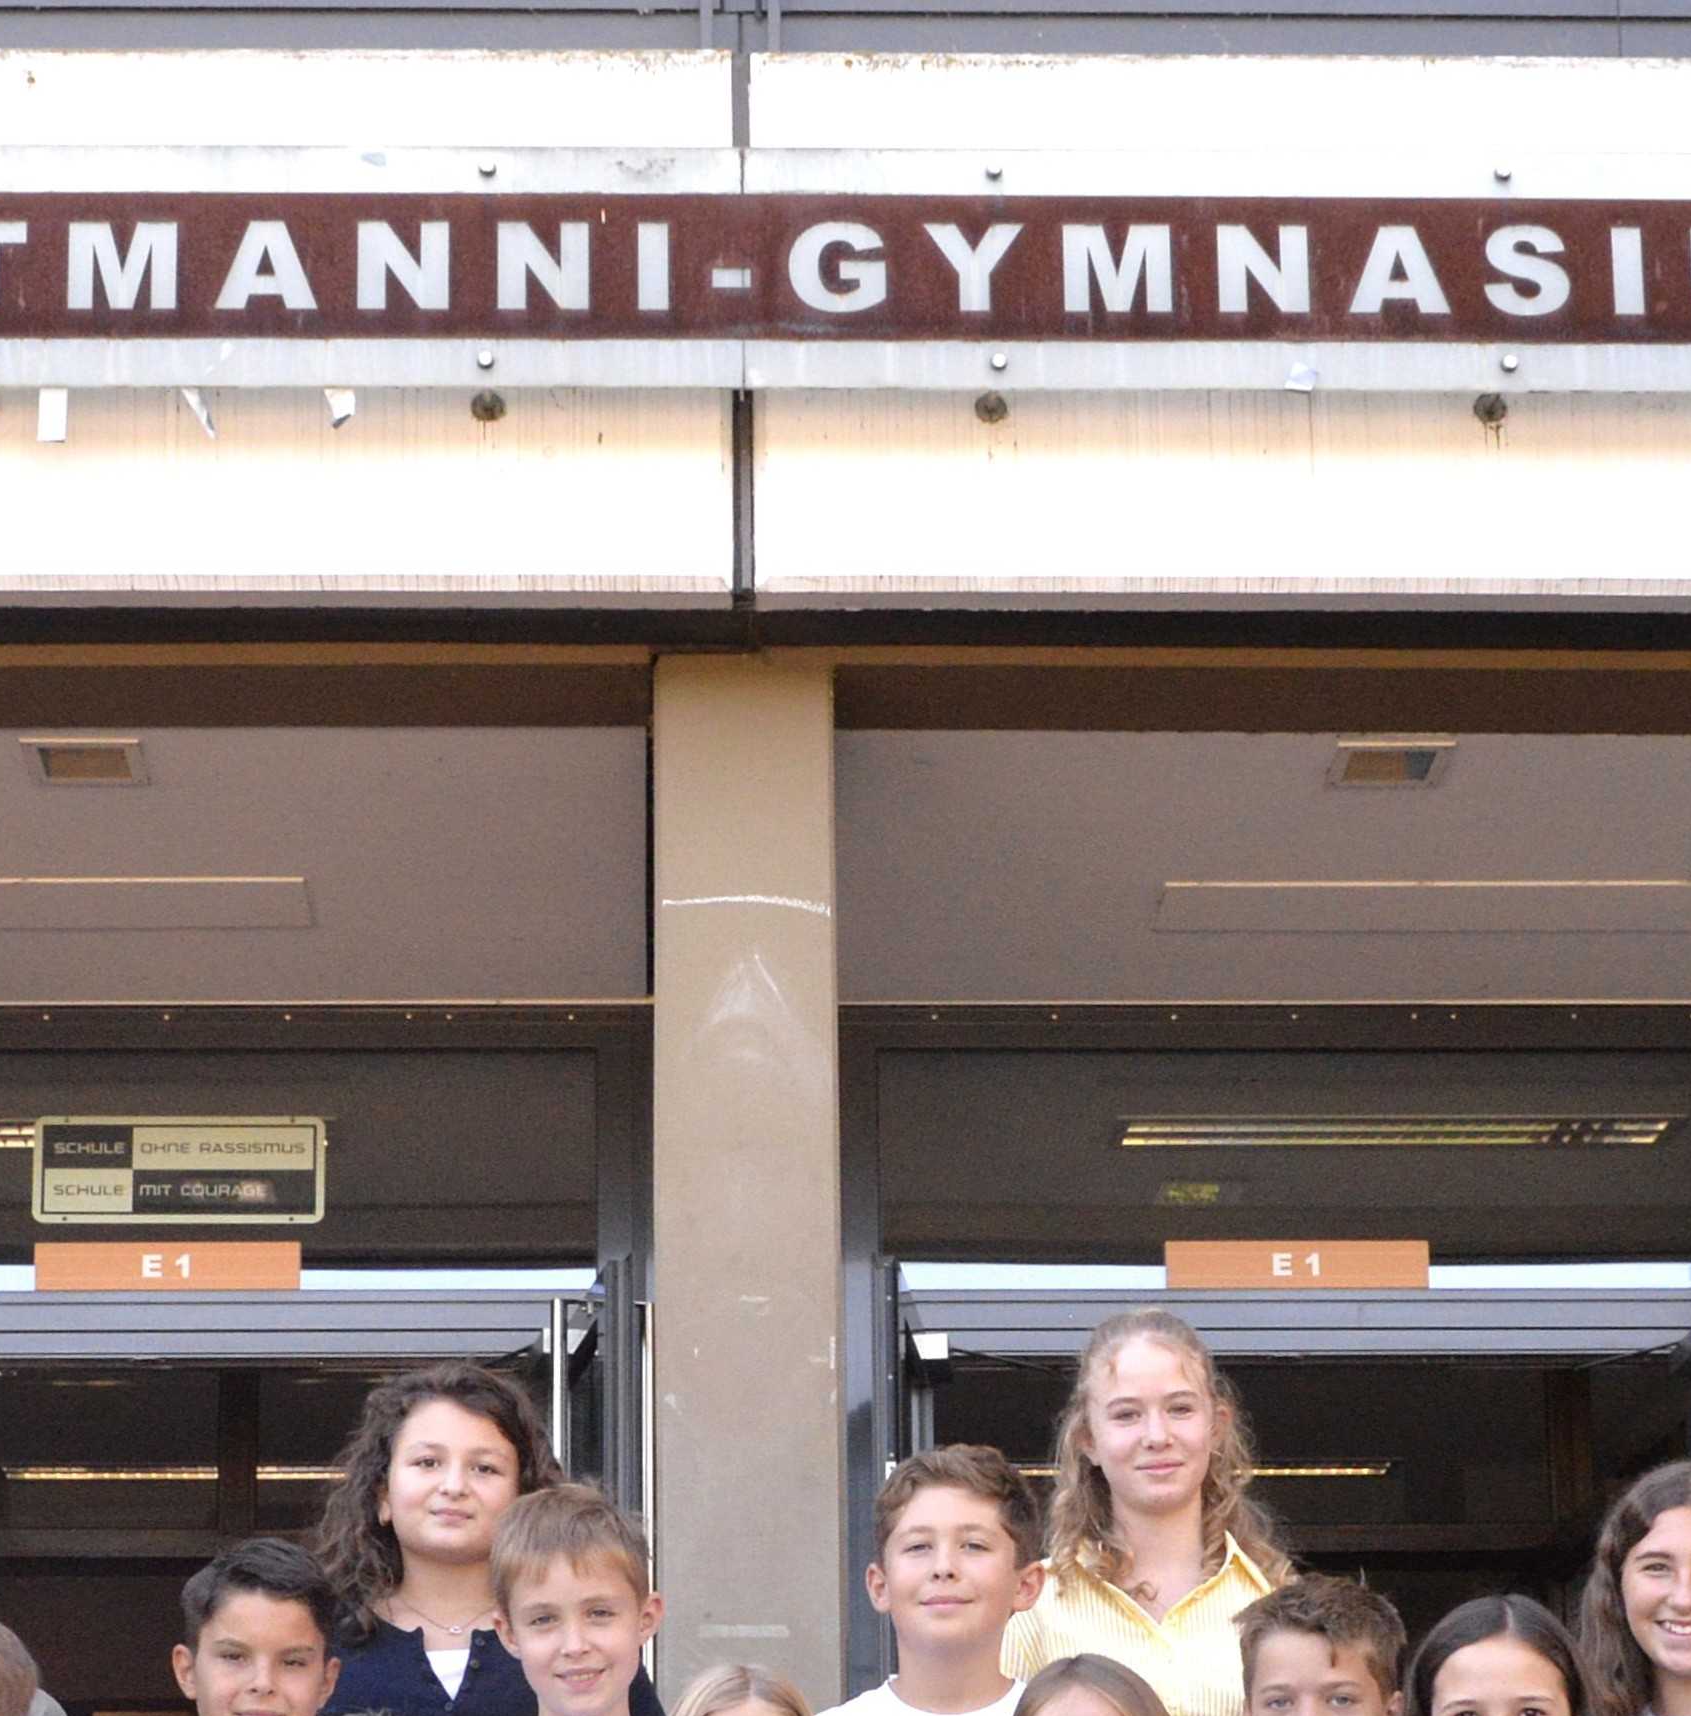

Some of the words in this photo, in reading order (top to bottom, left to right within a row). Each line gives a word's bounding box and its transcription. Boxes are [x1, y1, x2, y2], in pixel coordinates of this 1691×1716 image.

[53, 1142, 125, 1154] SCHULE
[140, 1142, 190, 1154] OHNE
[199, 1141, 306, 1155] RASSISMUS
[53, 1184, 124, 1196] SCHULE
[139, 1184, 173, 1197] MIT
[180, 1183, 269, 1198] COURAGE
[142, 1254, 163, 1278] E
[175, 1253, 191, 1279] 1
[1272, 1252, 1293, 1277] E
[1304, 1252, 1320, 1277] 1
